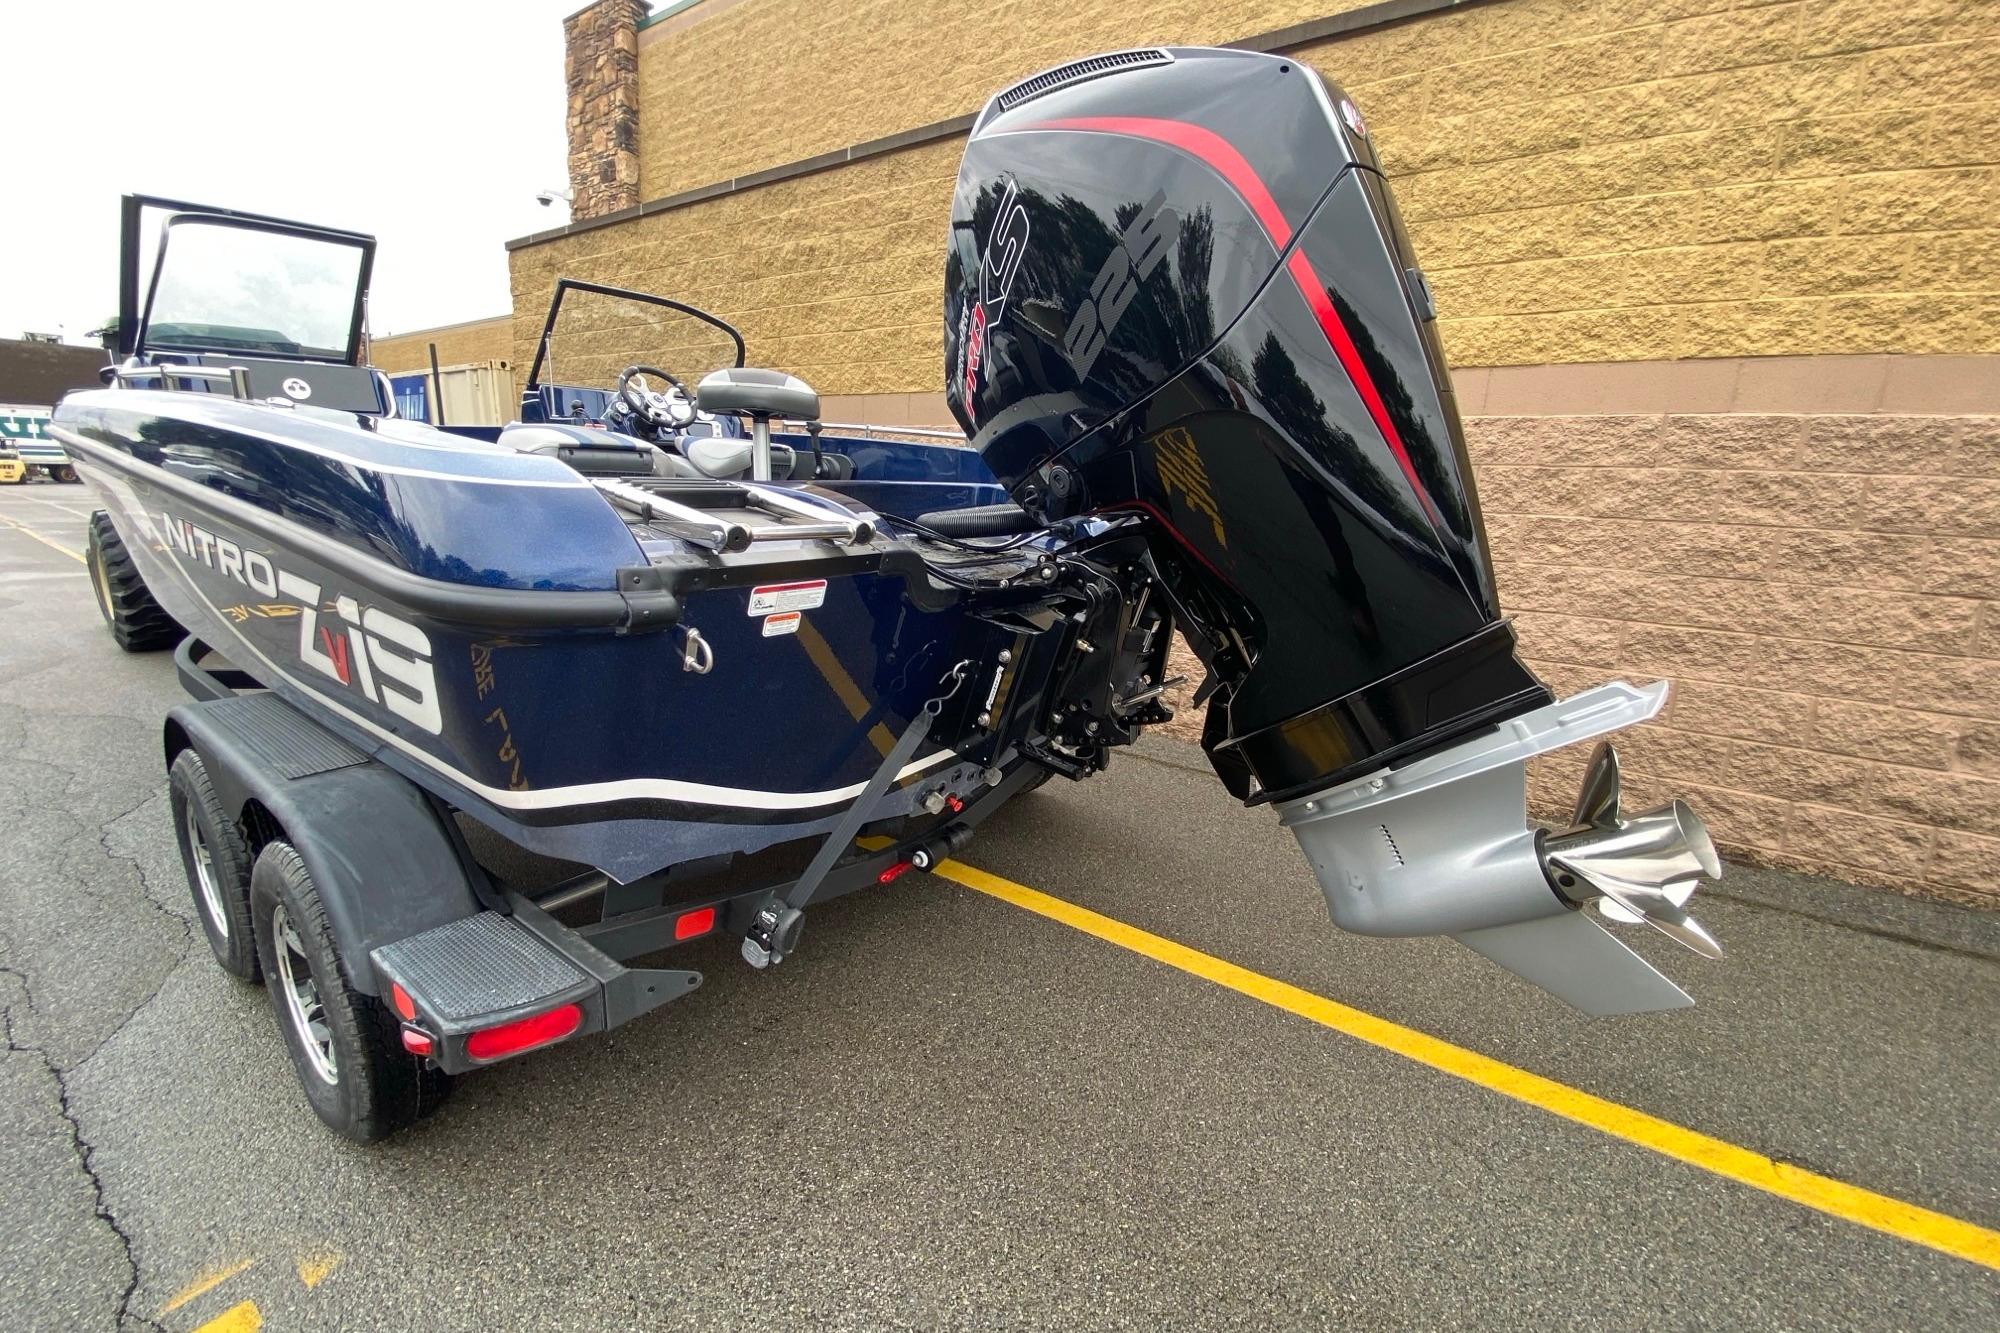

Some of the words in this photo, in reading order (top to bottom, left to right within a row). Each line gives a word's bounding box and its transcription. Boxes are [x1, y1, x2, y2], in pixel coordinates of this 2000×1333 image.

[1064, 188, 1180, 385] 225
[965, 302, 986, 423] PRO
[163, 512, 279, 599] NITRO
